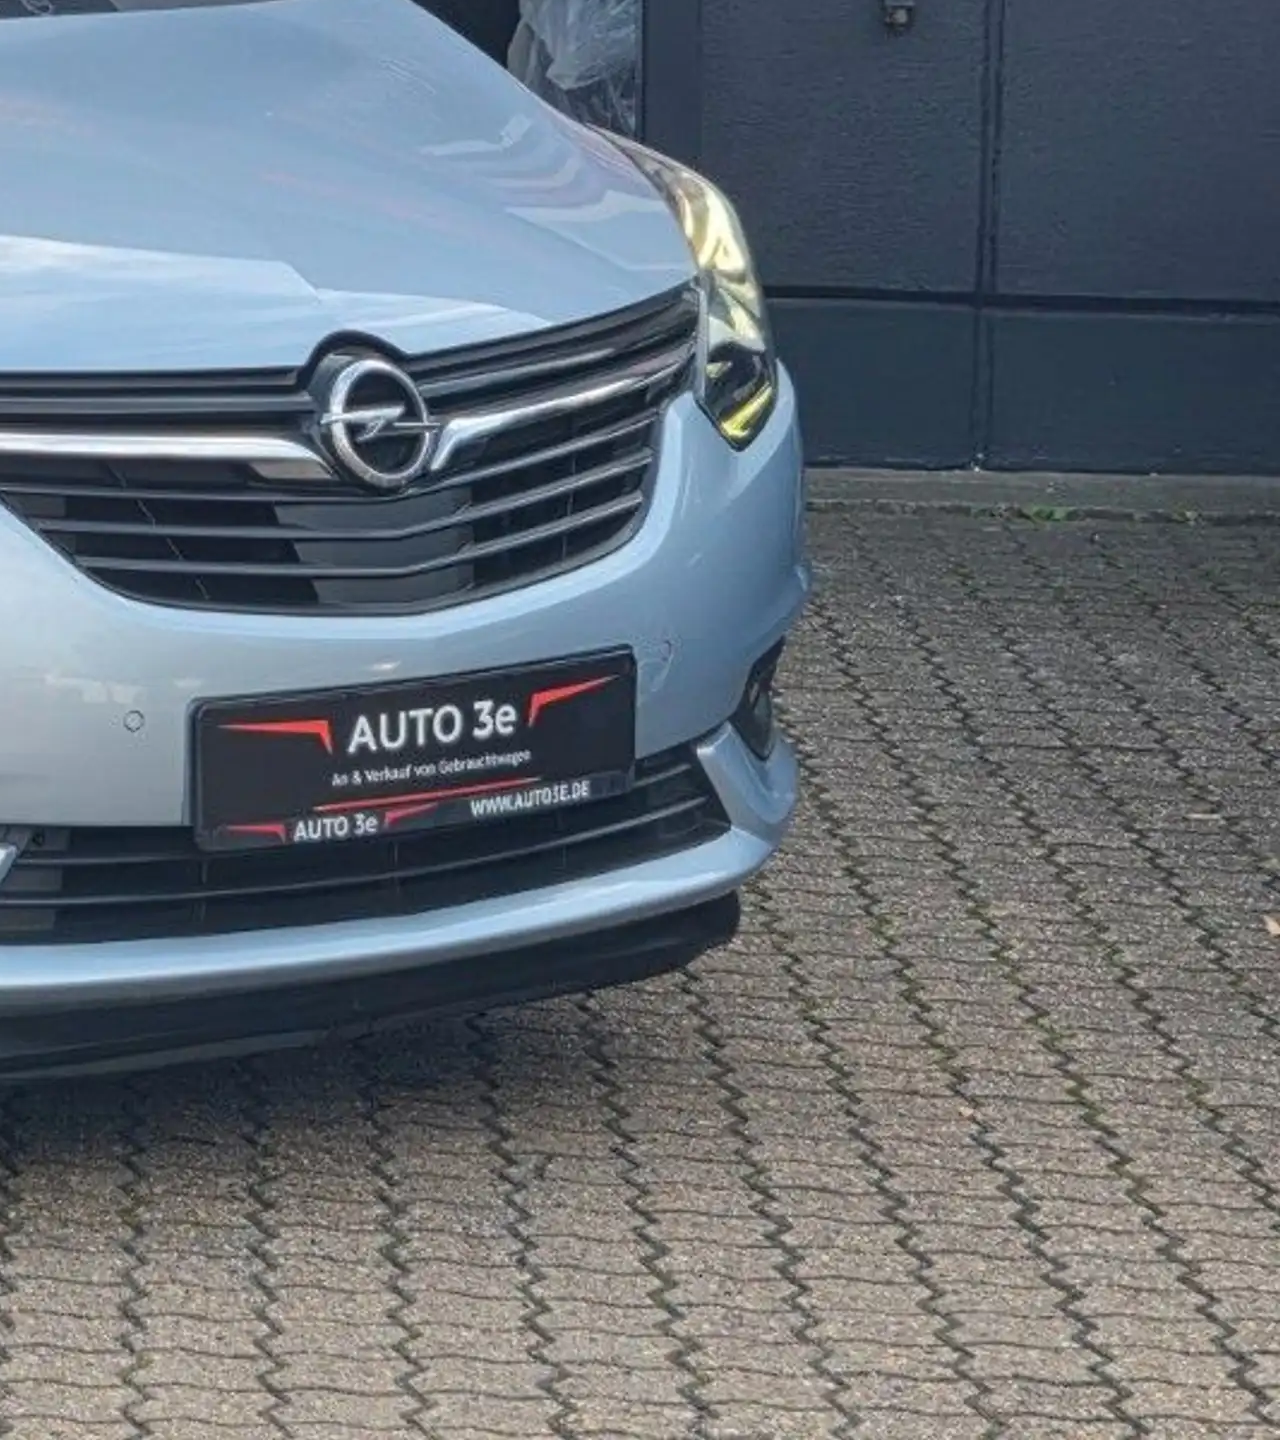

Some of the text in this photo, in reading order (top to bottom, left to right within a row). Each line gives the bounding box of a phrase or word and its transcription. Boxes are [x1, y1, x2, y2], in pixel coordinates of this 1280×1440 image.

[347, 699, 519, 755] AUTO 3e
[351, 769, 363, 786] &
[364, 764, 413, 782] Verkauf
[413, 762, 437, 777] von
[438, 749, 533, 775] Gebrauchtwagen
[293, 812, 379, 843] AUTO 3e
